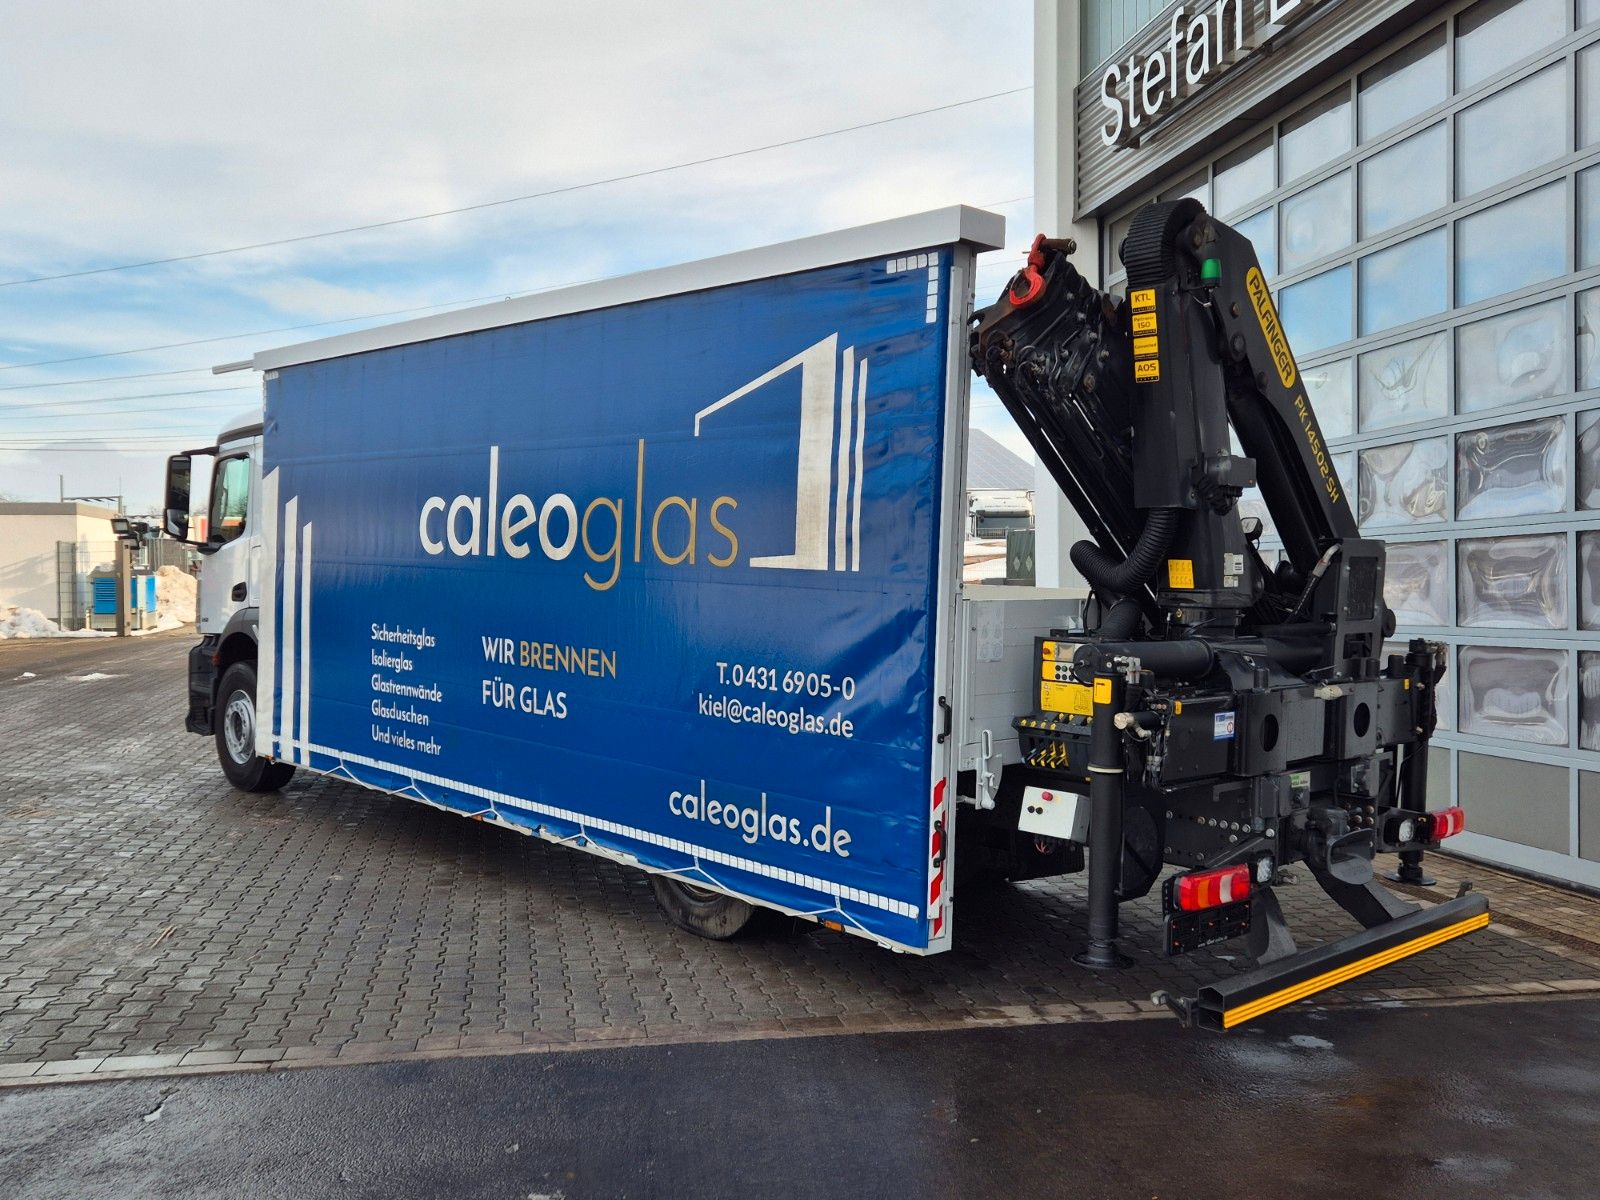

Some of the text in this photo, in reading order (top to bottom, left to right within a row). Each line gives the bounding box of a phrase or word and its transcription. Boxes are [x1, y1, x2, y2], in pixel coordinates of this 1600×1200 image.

[1101, 0, 1243, 146] Stefan
[1134, 293, 1151, 303] KTL
[1250, 275, 1292, 382] PALFINGER
[1137, 362, 1157, 373] AOS
[1294, 394, 1309, 423] PK
[419, 438, 739, 591] caleoglas
[371, 622, 436, 651] Sicherheitsglas
[371, 648, 413, 674] Isolierglas
[481, 635, 617, 680] WIR BRENNEN
[371, 673, 442, 703] Glastrennwände
[482, 676, 568, 719] FÜR GLAS
[782, 670, 856, 700] 6905-0
[371, 698, 429, 726] Glasduschen
[698, 692, 854, 738] kiel@caleoglas.de
[371, 723, 442, 756] Und vieles mehr
[668, 779, 852, 859] caleoglas.de
